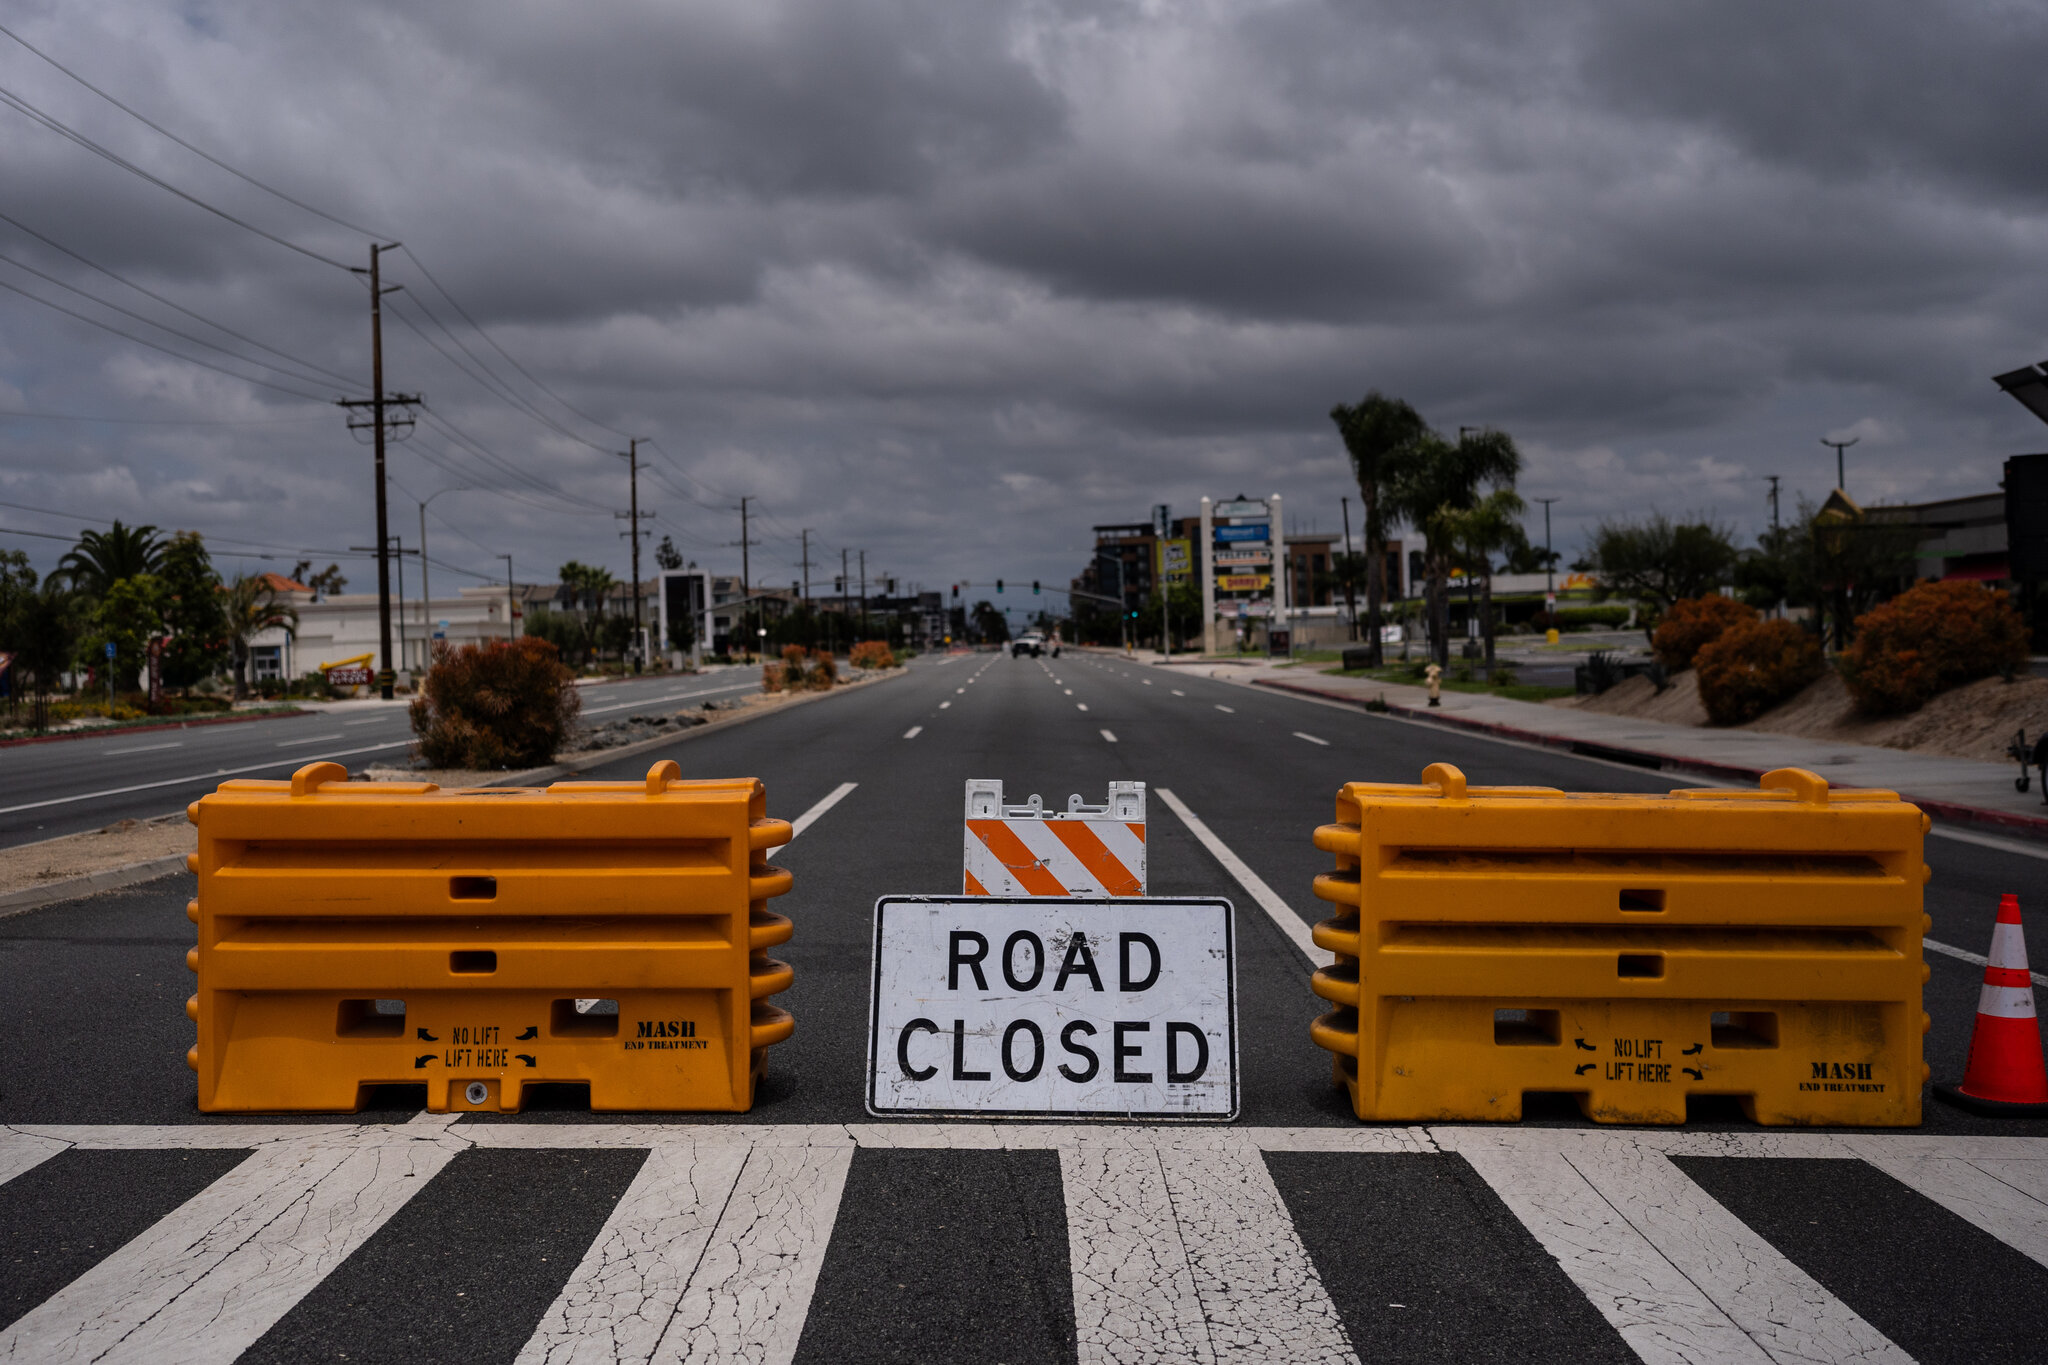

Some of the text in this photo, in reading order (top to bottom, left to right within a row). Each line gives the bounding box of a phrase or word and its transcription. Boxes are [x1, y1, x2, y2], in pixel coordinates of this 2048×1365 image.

[947, 929, 1161, 992] ROAD
[453, 1026, 500, 1045] NO LIFT
[637, 1021, 696, 1038] MASH
[624, 1040, 709, 1050] END TREATMENT
[896, 1017, 1209, 1084] CLOSED
[1614, 1038, 1663, 1059] NO LIFT
[445, 1048, 508, 1067] LIFT HERE
[1606, 1062, 1672, 1083] LIFT HERE
[1811, 1062, 1873, 1080] MASH
[1799, 1082, 1886, 1093] END TREATMENT
